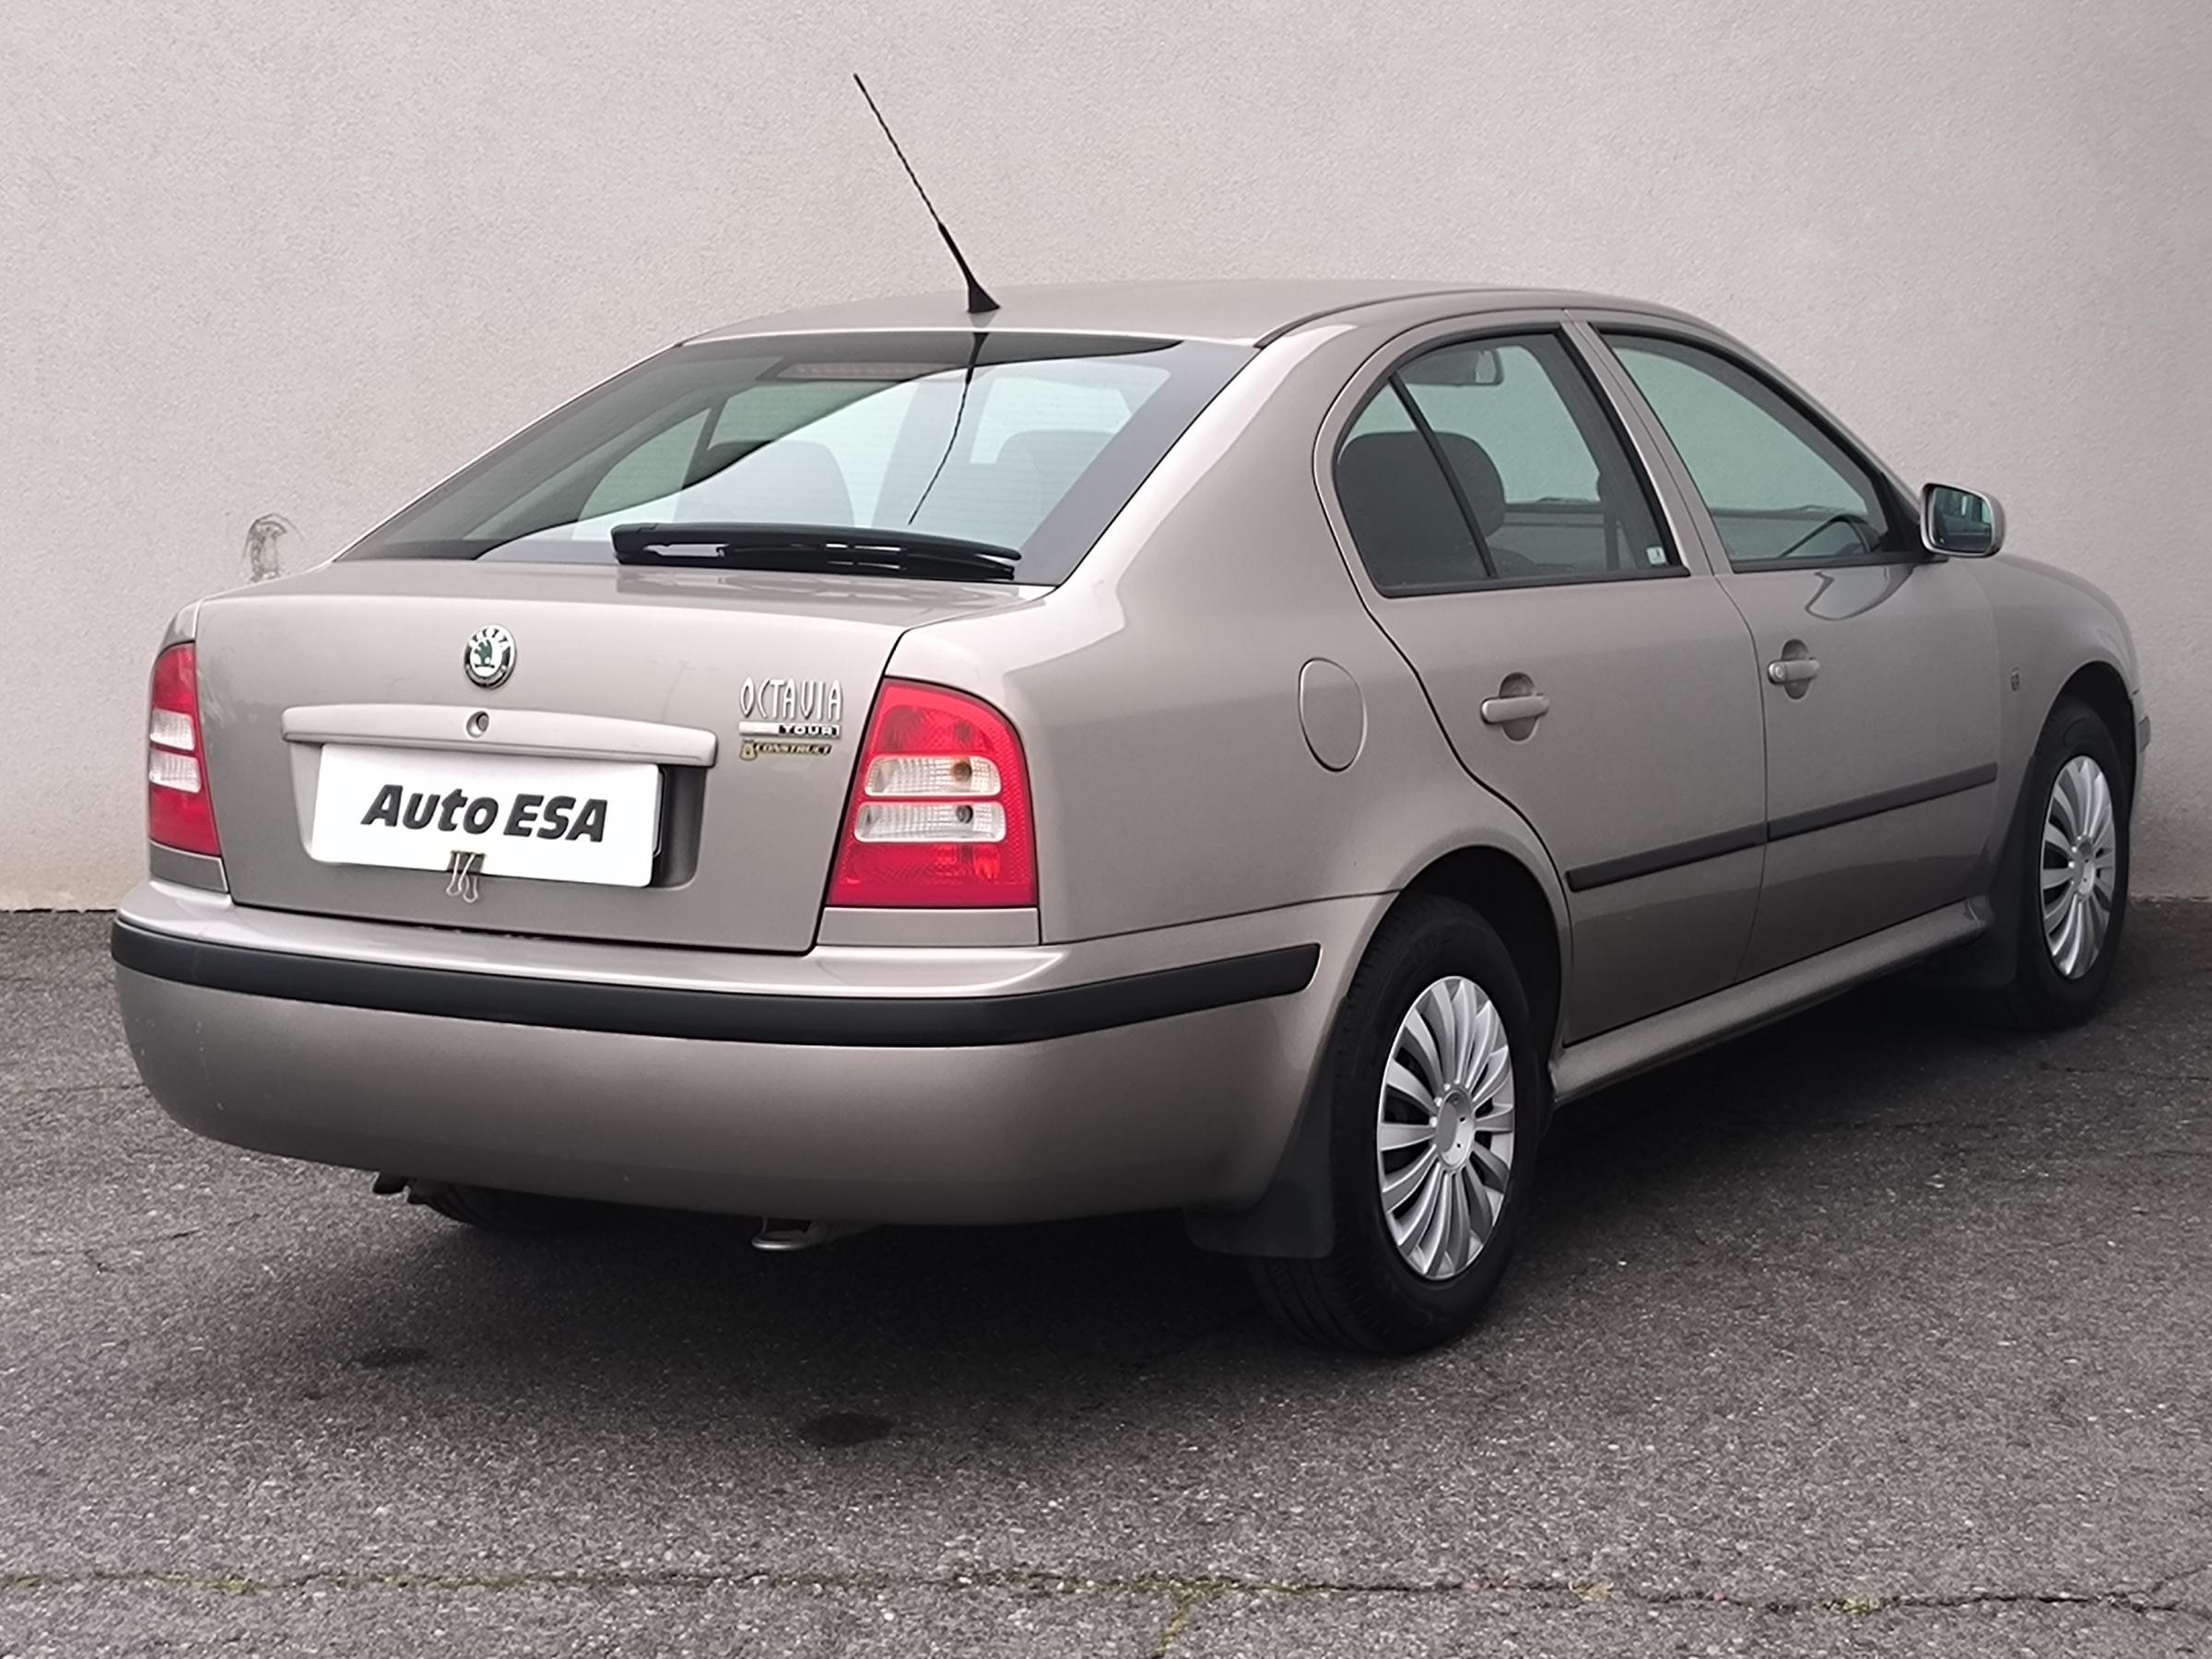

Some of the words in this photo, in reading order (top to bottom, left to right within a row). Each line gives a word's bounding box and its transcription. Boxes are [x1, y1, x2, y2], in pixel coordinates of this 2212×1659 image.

[740, 677, 842, 720] OCTAVIA
[780, 724, 833, 736] TOUR
[361, 784, 499, 834] Auto
[503, 794, 607, 842] ESA
